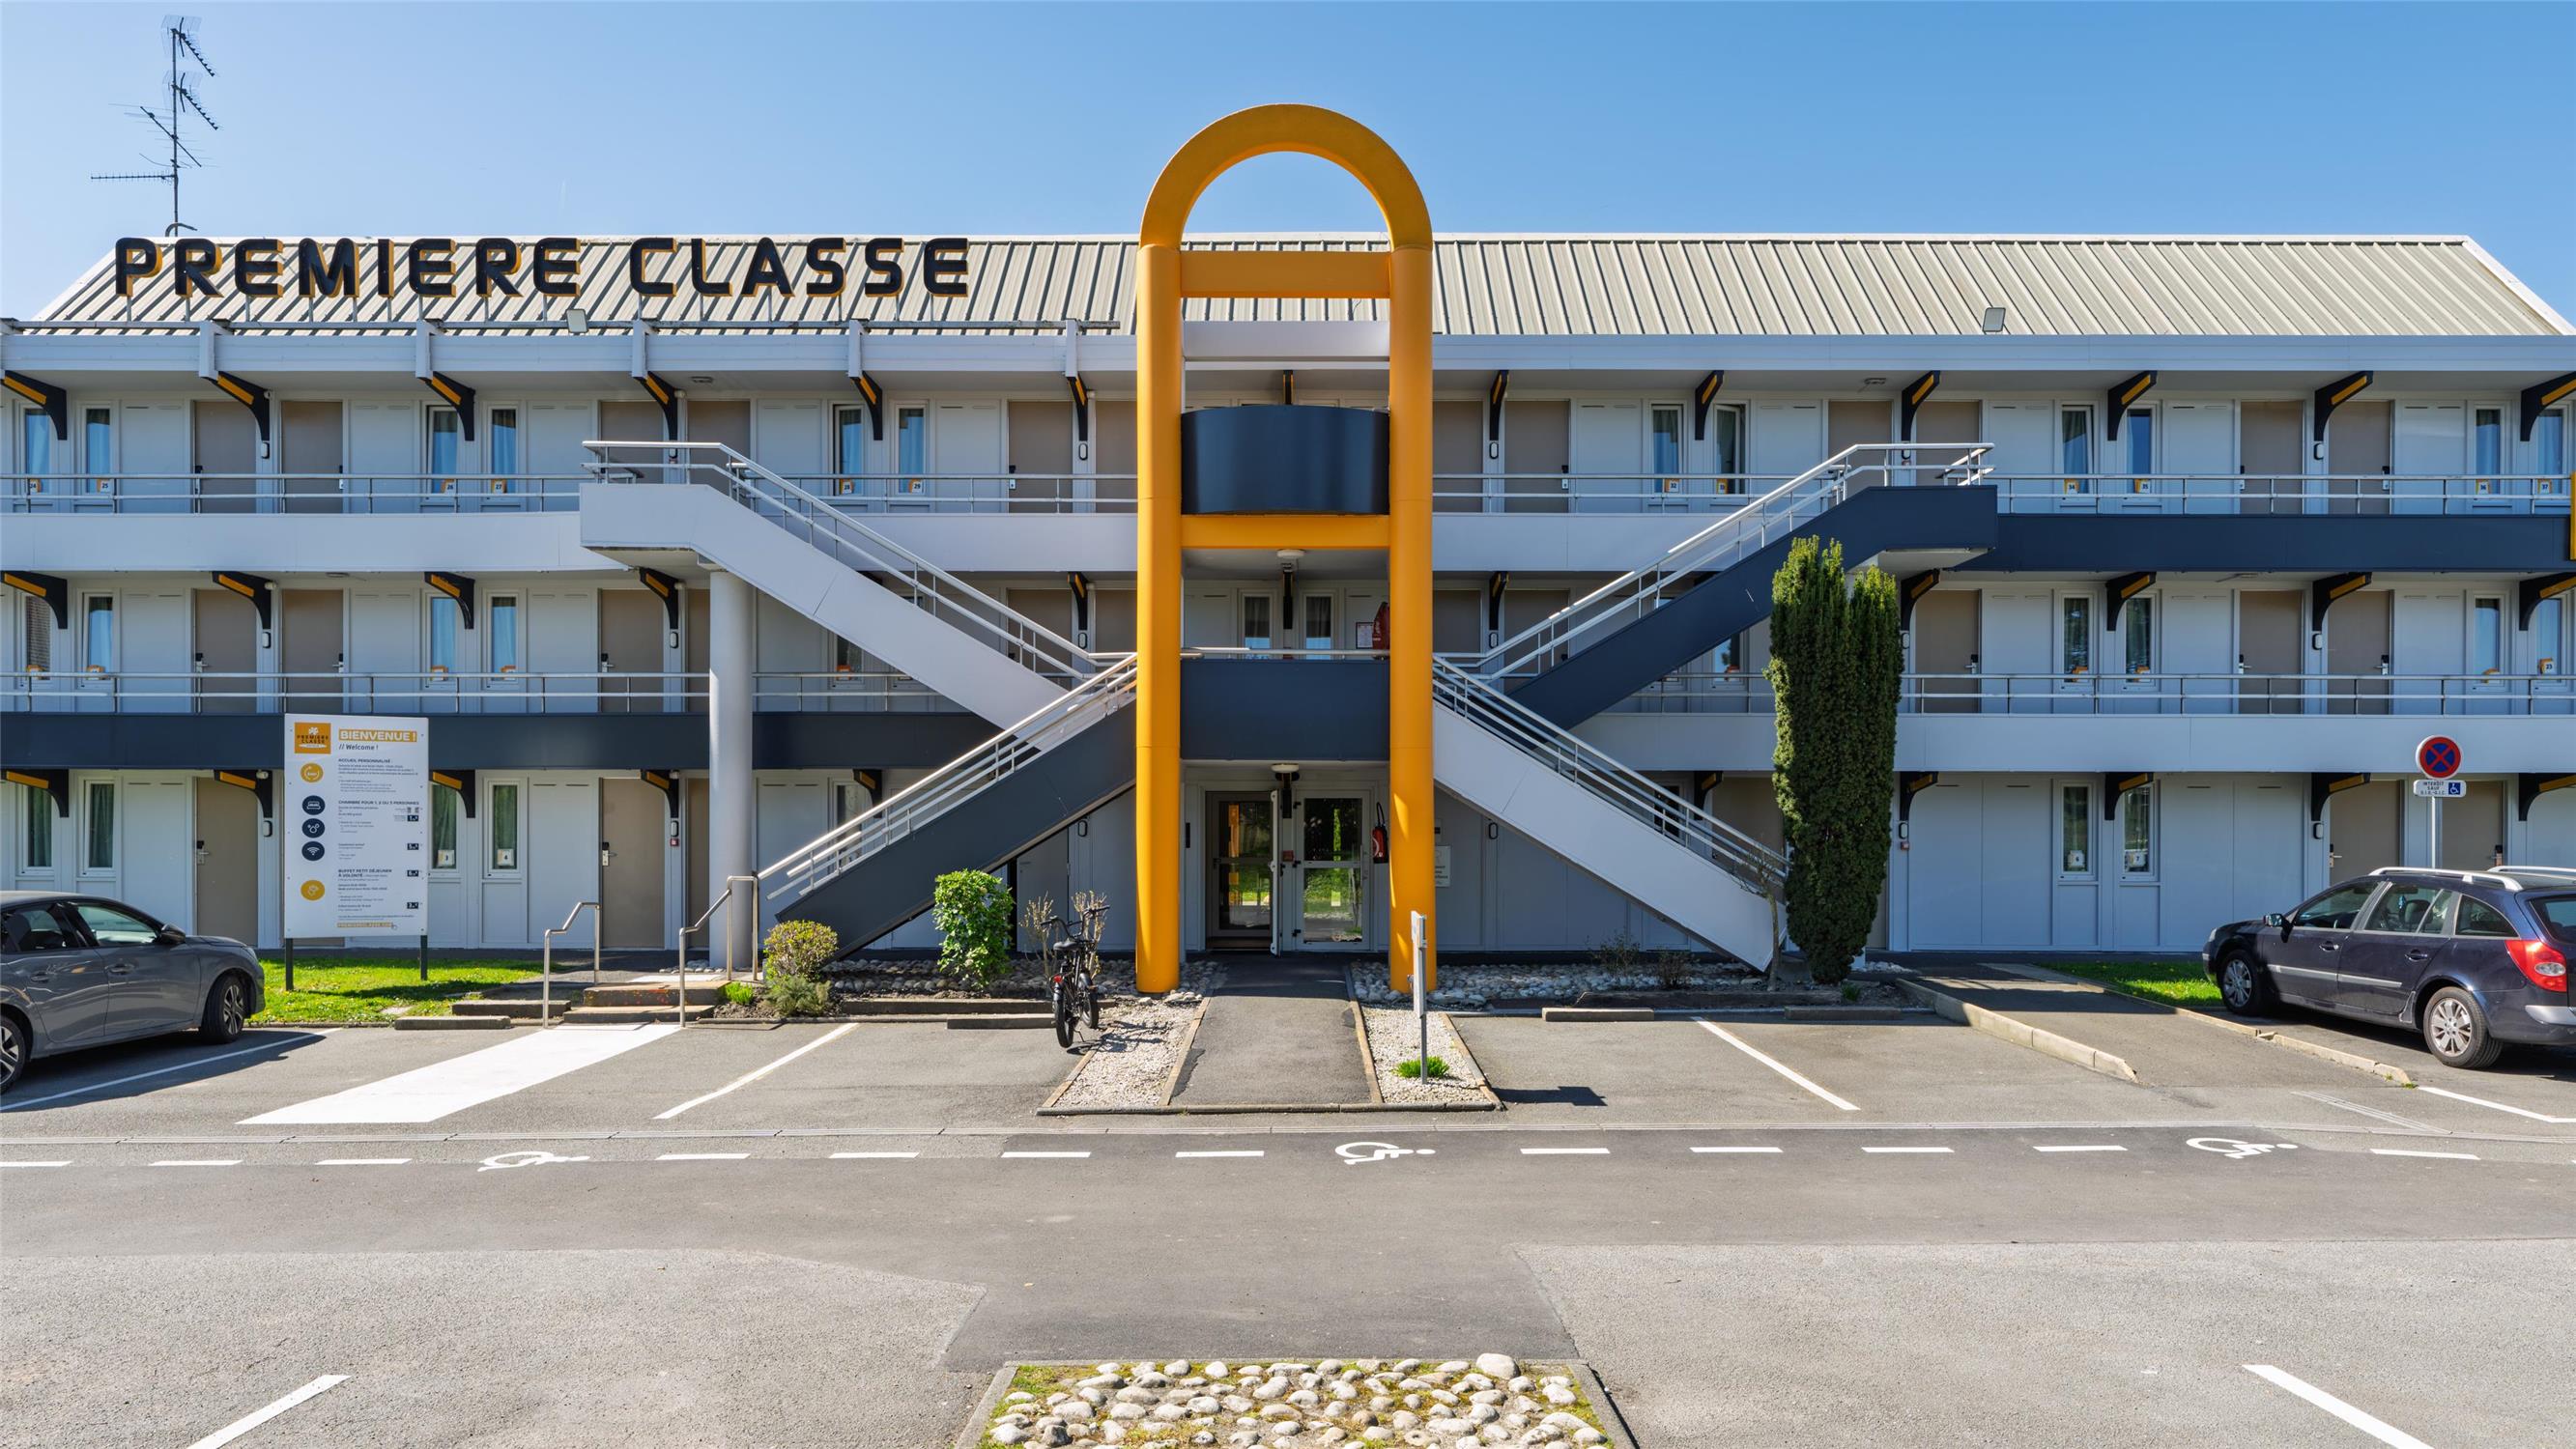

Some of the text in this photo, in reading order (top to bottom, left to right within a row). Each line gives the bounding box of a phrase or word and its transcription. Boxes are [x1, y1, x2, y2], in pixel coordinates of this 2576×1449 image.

[115, 237, 969, 298] PREMIERE CLASSE
[340, 730, 411, 742] BIENVENUE
